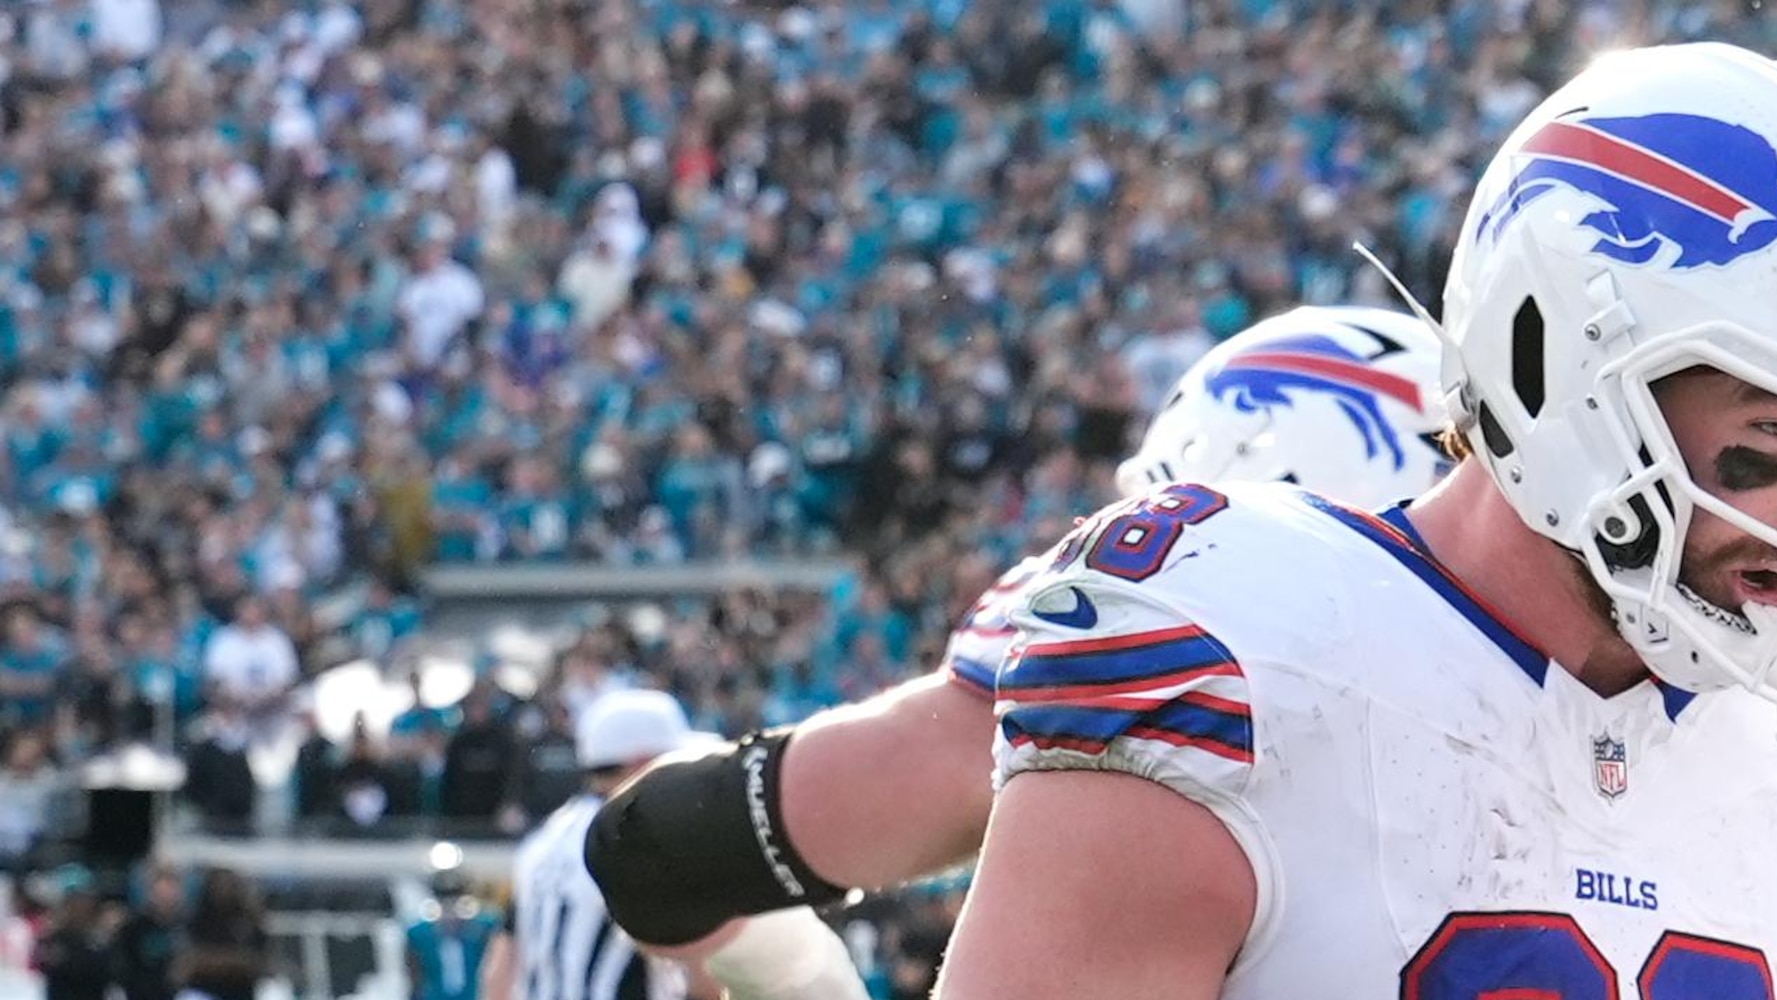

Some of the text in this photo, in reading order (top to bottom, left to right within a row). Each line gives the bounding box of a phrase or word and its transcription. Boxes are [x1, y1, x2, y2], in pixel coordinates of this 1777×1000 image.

[1600, 763, 1626, 791] NFL
[746, 762, 806, 897] MUELLER
[1576, 868, 1658, 910] BILLS
